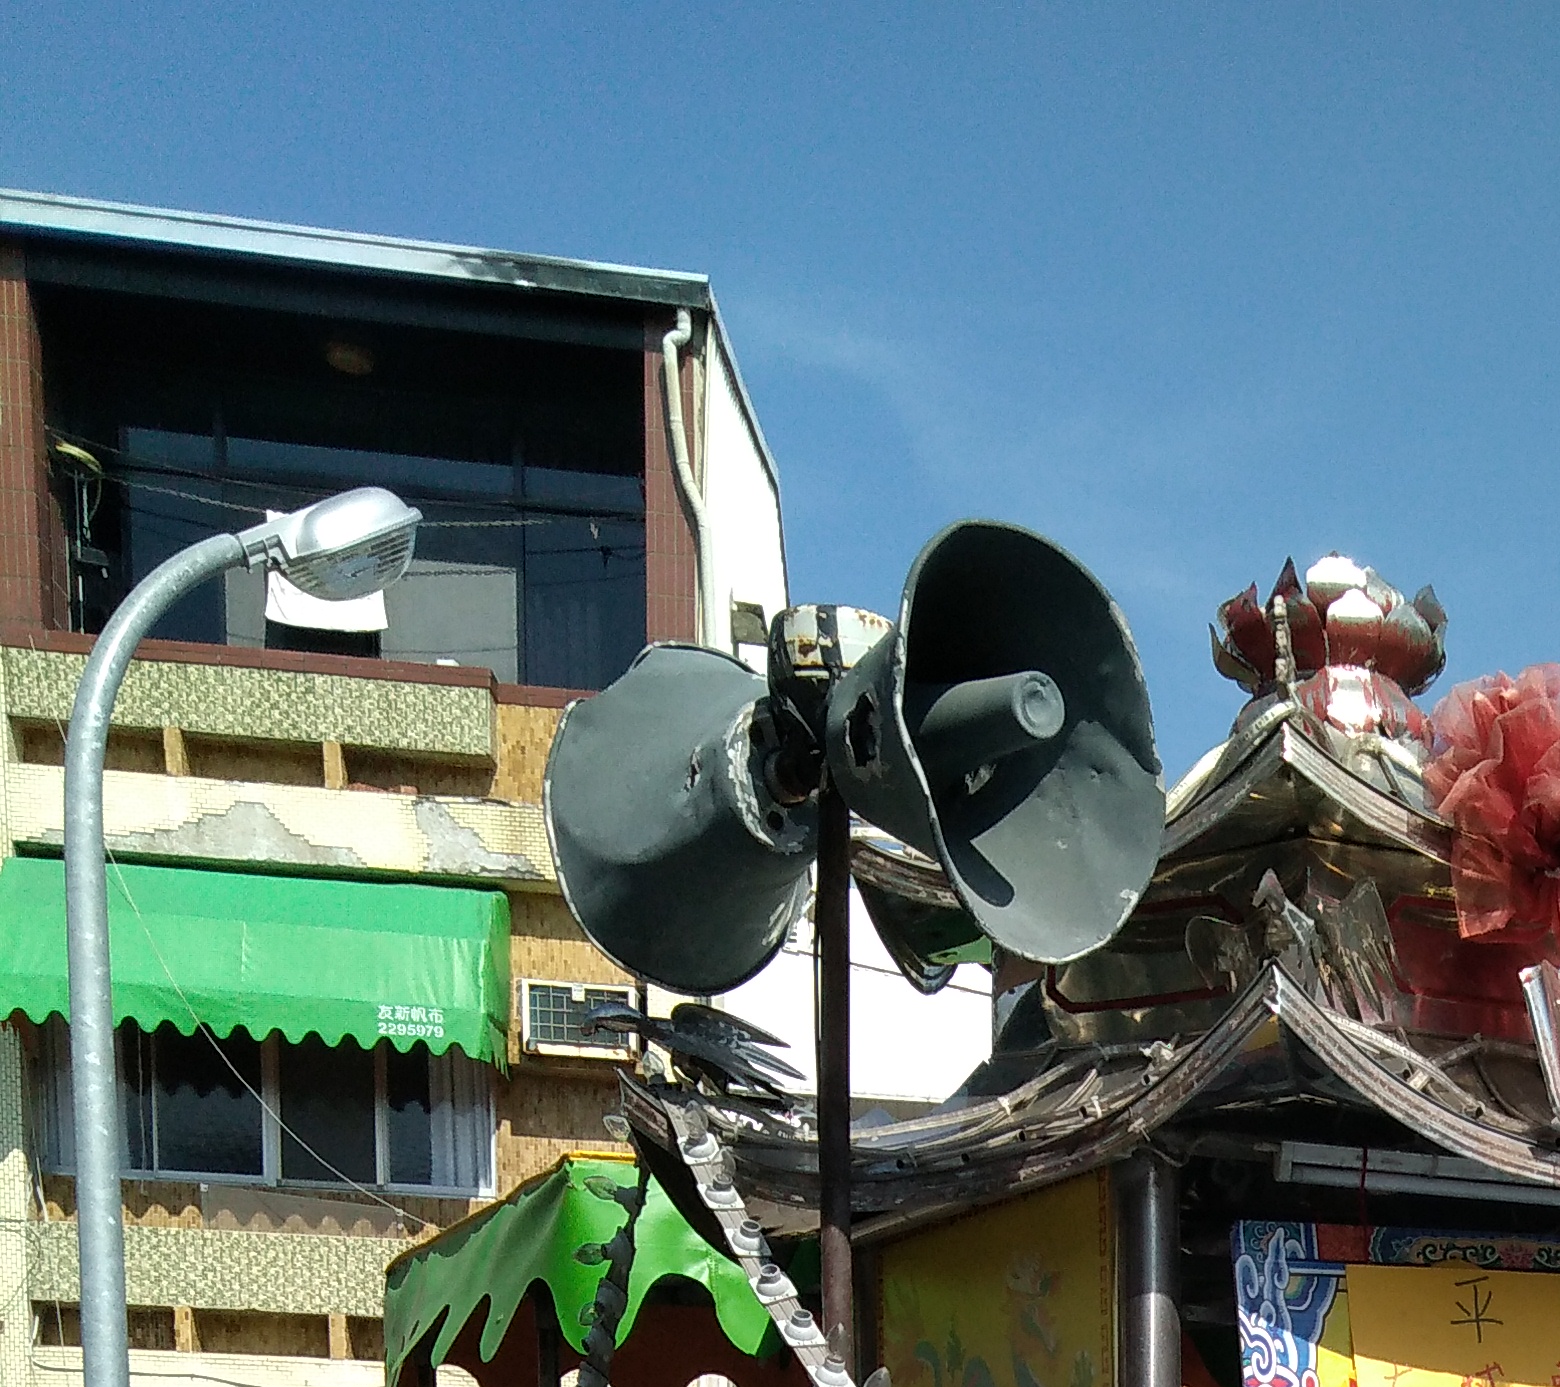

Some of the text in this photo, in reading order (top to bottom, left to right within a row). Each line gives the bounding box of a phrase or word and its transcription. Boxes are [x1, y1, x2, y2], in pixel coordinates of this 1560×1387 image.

[377, 1005, 444, 1024] 友新帆布
[378, 1022, 445, 1038] 2295979
